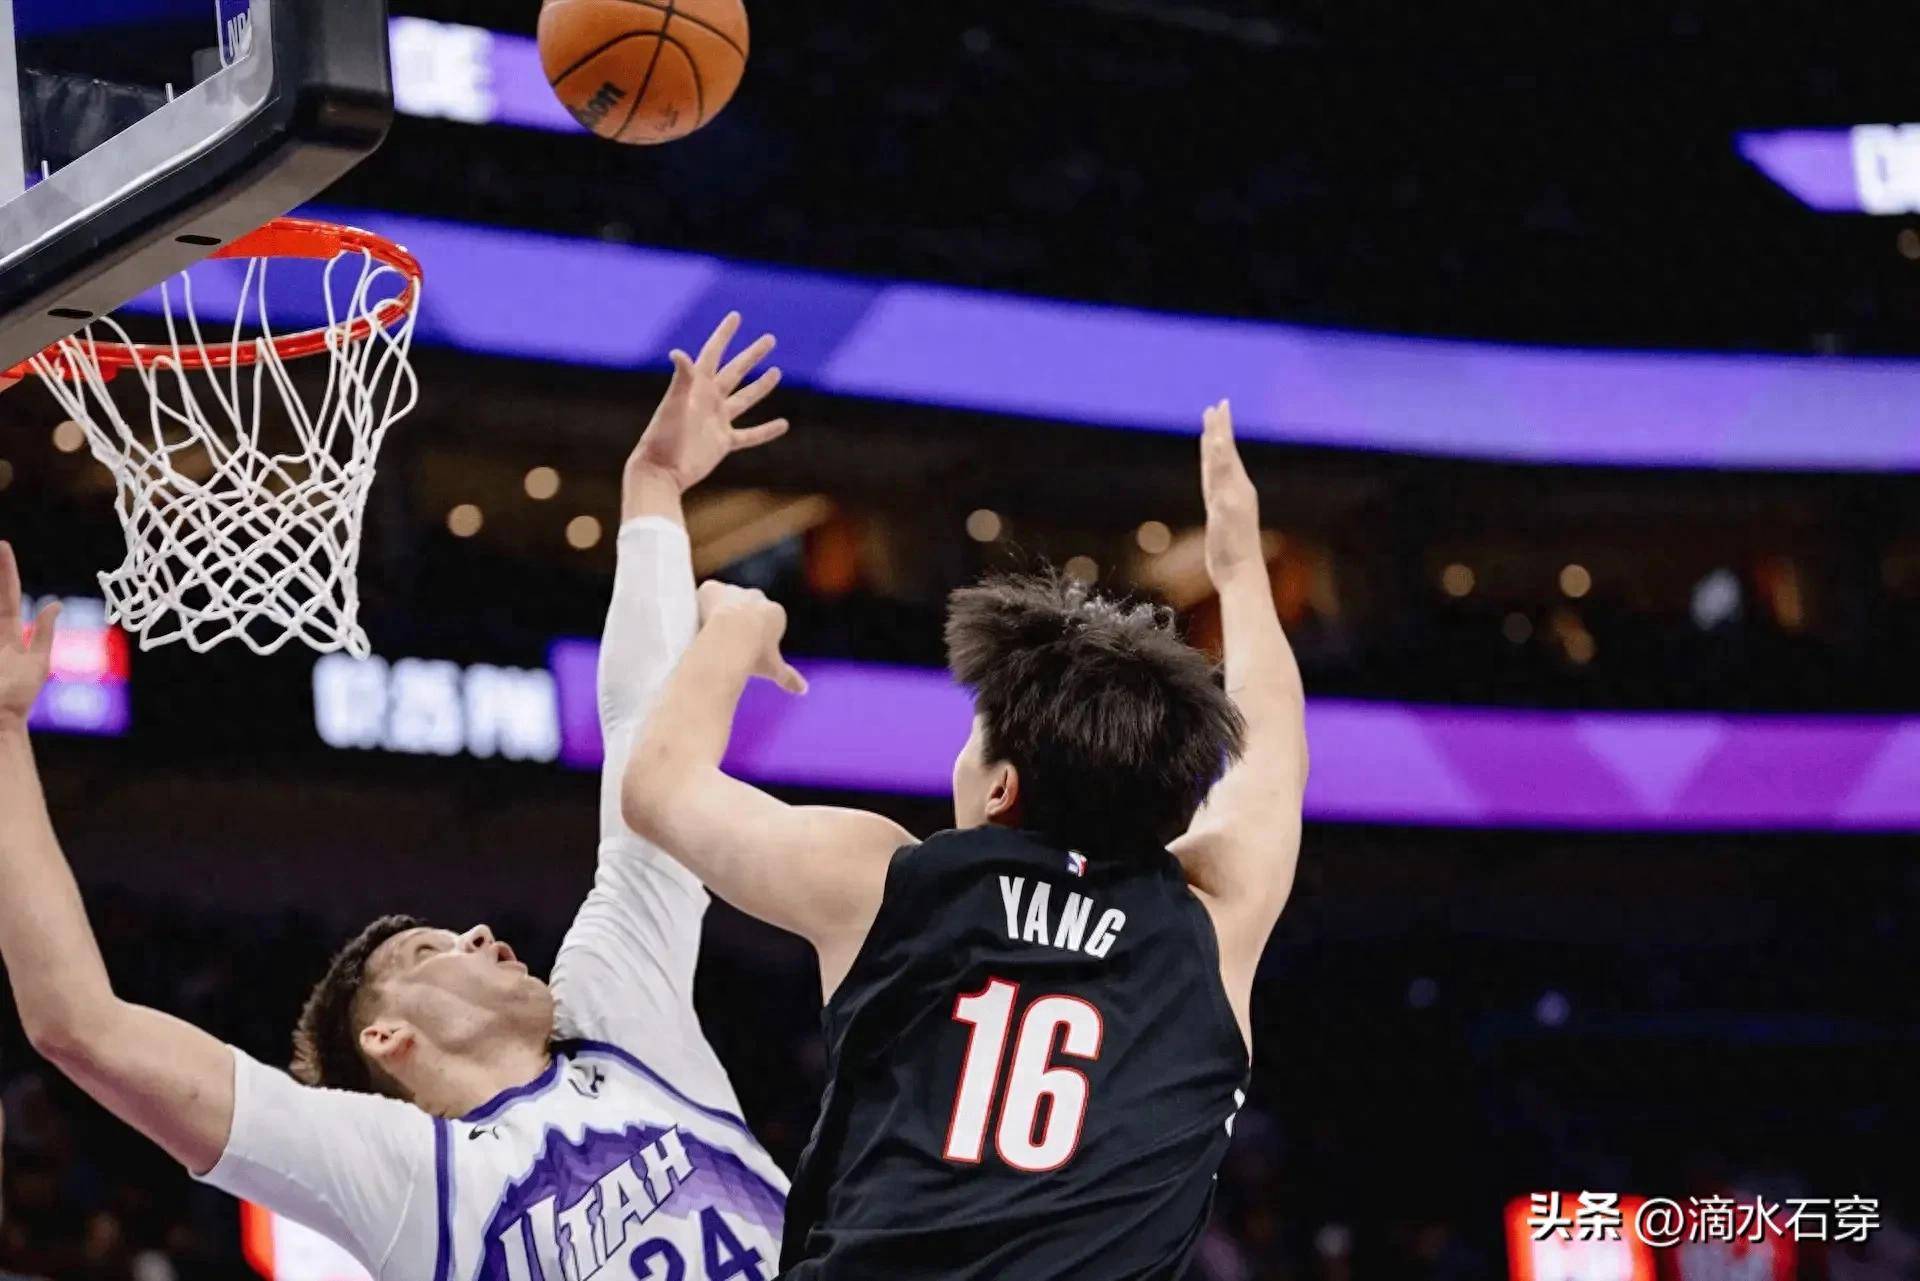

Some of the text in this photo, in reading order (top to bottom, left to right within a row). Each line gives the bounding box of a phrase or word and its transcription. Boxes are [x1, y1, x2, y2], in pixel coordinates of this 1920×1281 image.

[227, 8, 252, 58] NB
[1000, 875, 1126, 959] YANG
[943, 976, 1104, 1173] 16
[499, 1124, 697, 1281] UTAH
